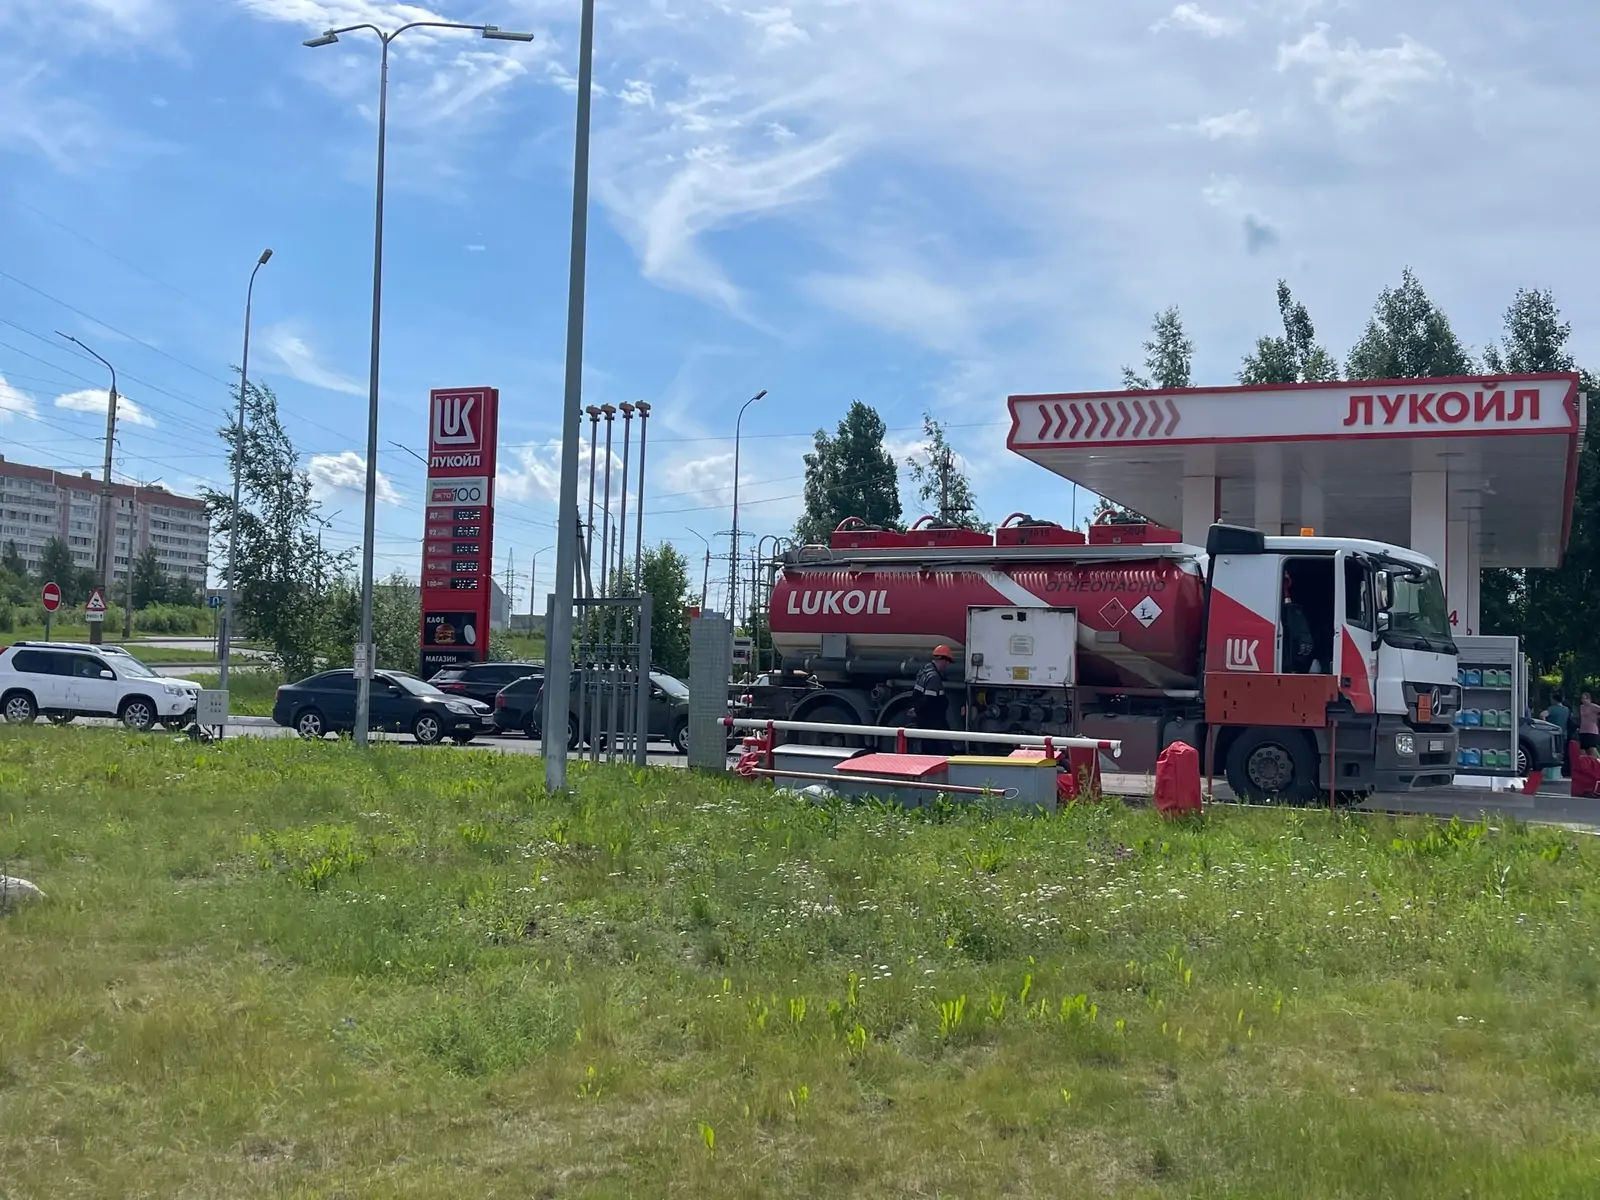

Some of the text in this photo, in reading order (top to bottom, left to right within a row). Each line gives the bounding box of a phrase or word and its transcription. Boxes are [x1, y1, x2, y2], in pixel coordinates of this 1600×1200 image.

[1343, 382, 1540, 426] ЛУКОЙЛ
[430, 453, 480, 468] ЛУКОЙЛ
[453, 487, 481, 502] 100
[1045, 580, 1166, 593] ОГНЕОПАСНО
[787, 589, 891, 616] LUKOIL
[426, 616, 445, 624] КАФЕ
[425, 655, 457, 663] МАГАЗИН
